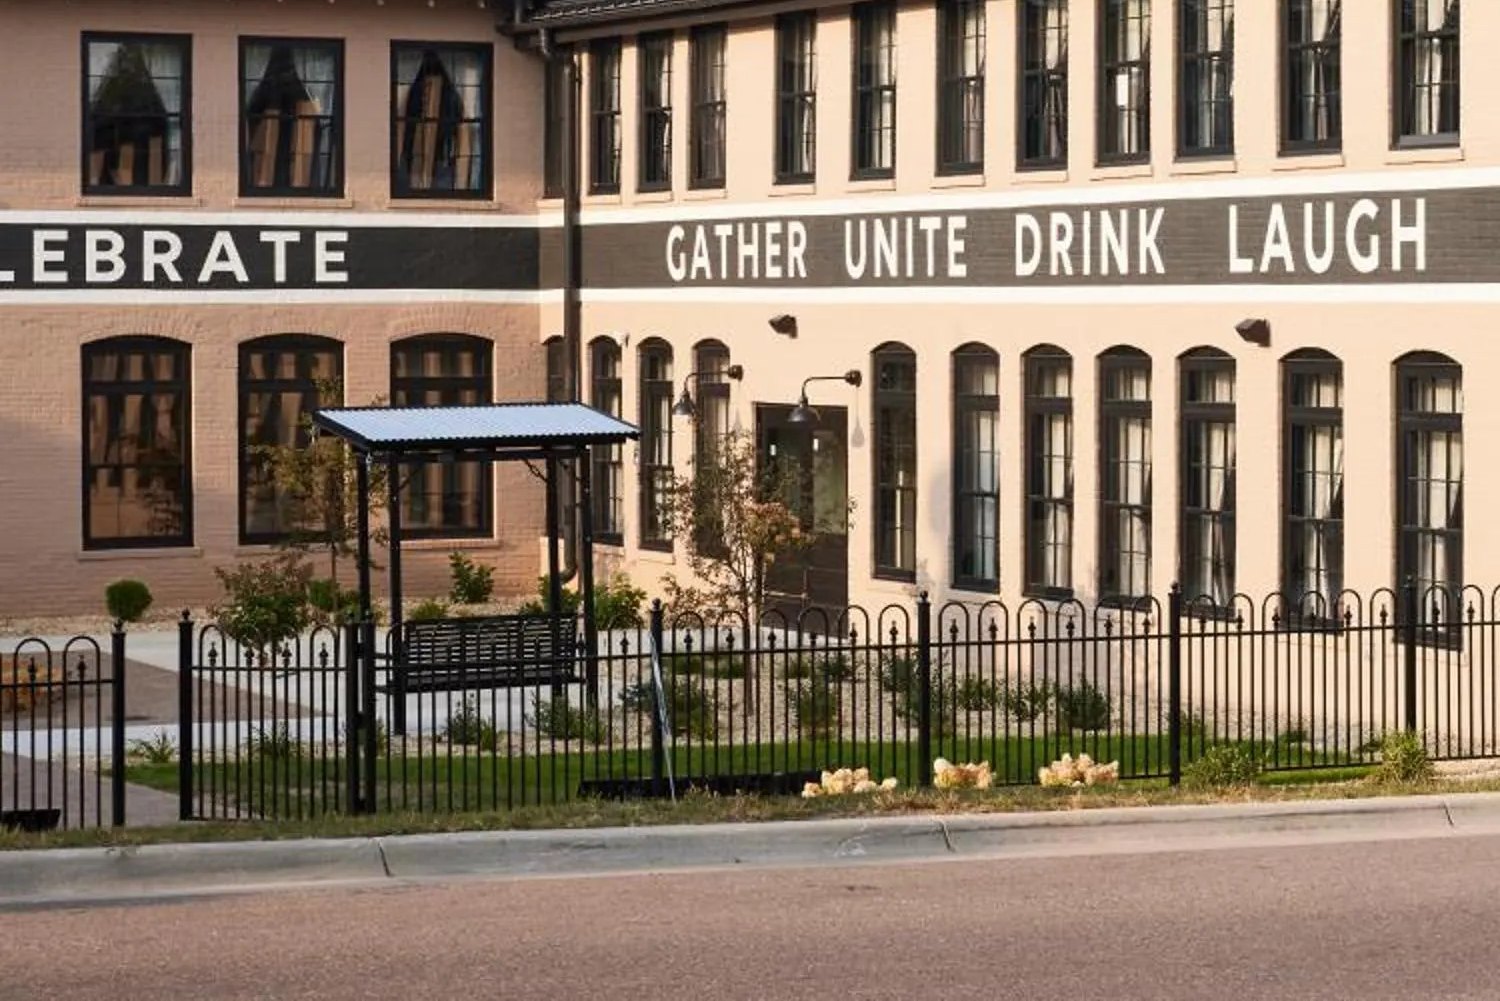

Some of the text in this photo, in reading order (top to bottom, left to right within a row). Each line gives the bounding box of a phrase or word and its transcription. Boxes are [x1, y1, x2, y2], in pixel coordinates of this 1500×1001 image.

[665, 197, 1427, 281] GATHER UNITE DRINK LAUGH
